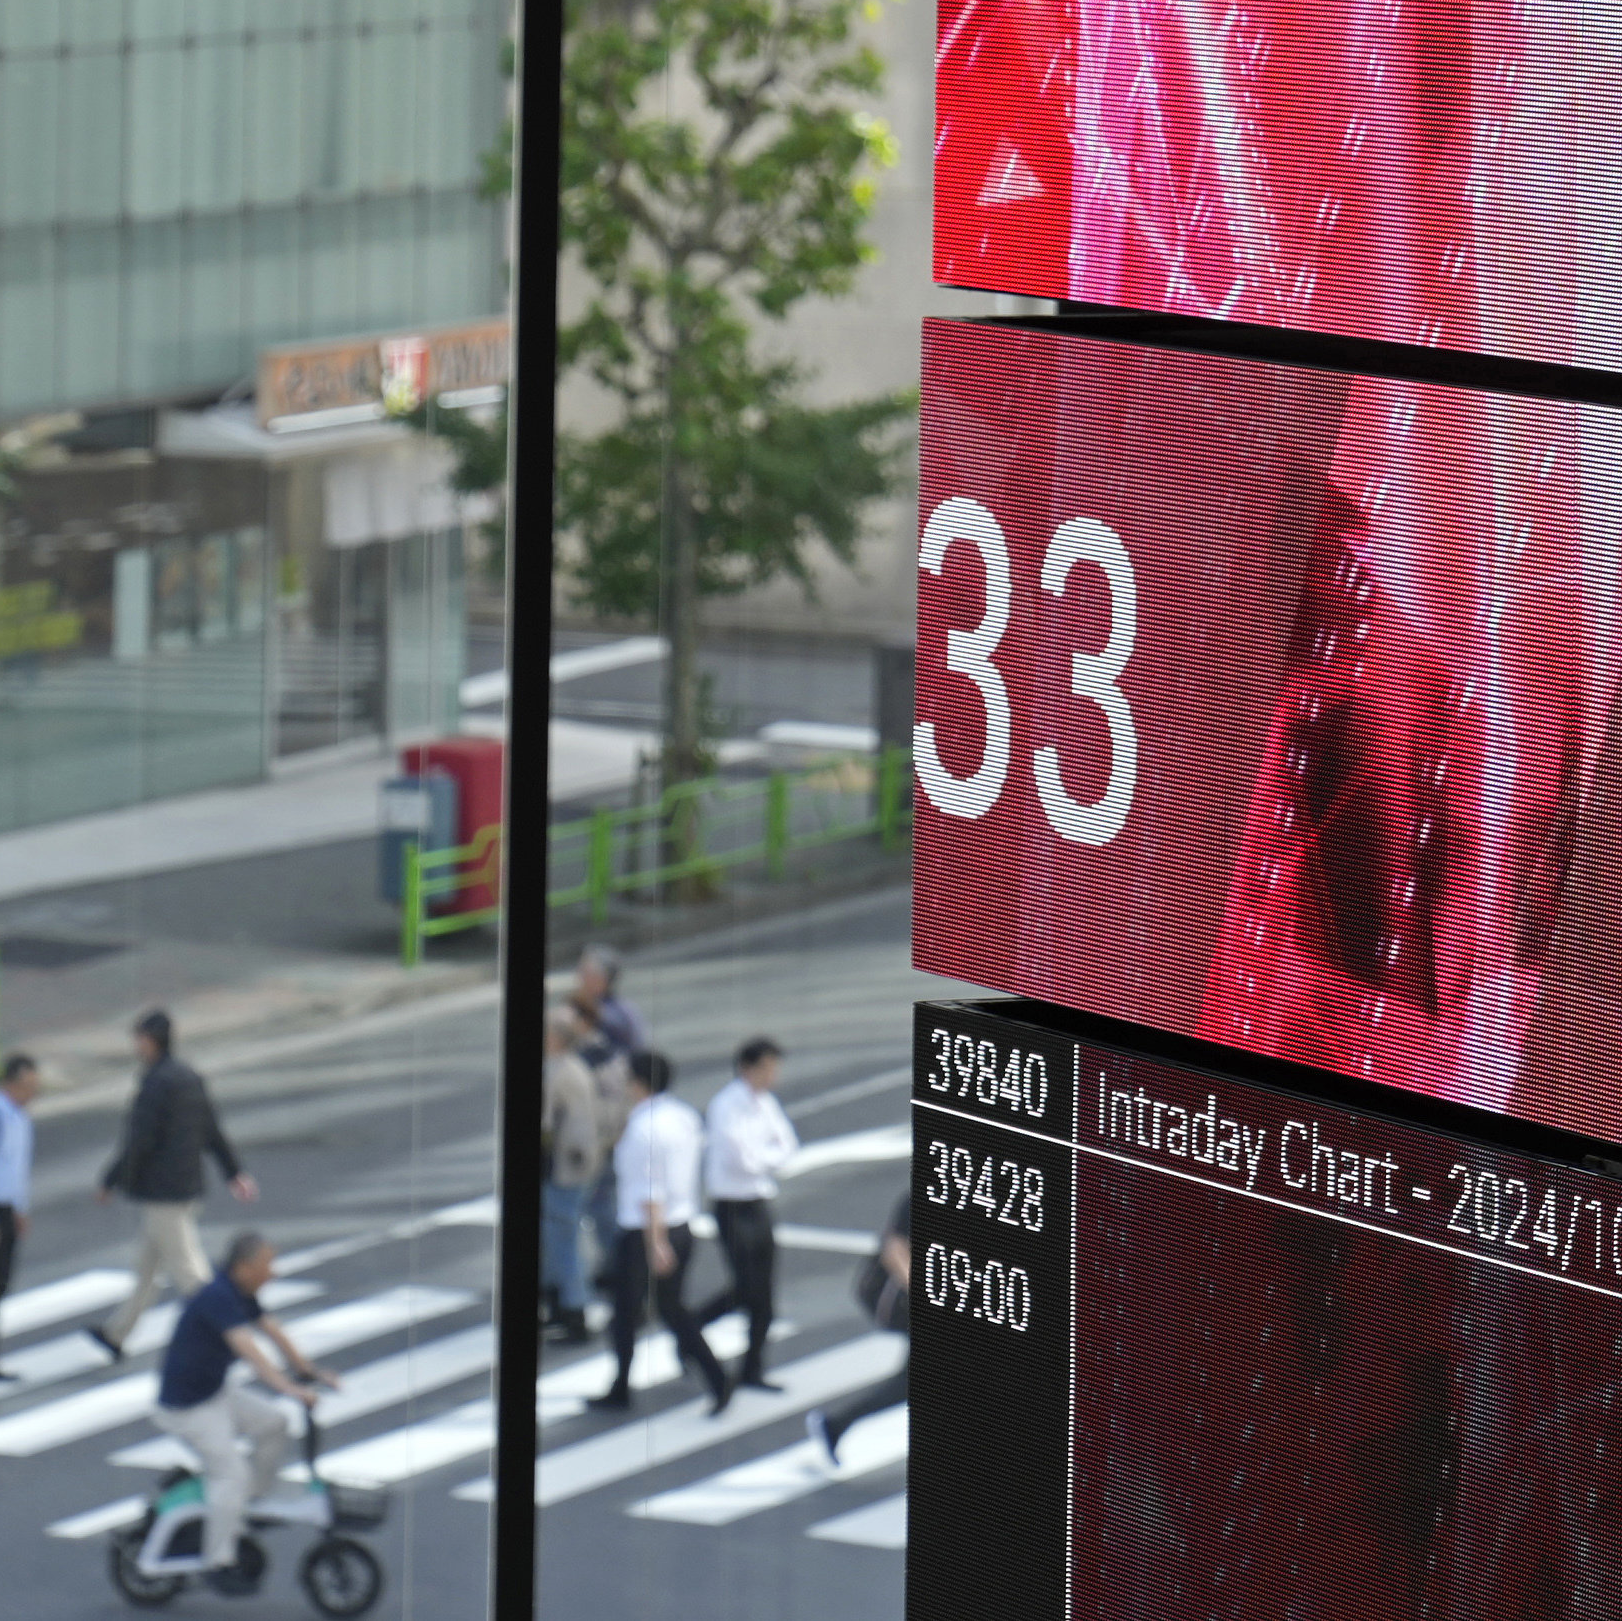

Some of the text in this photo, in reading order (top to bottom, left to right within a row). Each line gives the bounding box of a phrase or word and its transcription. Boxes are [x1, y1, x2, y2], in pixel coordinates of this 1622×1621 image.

[912, 497, 1139, 845] 33
[928, 1028, 1049, 1118] 39840
[926, 1141, 1045, 1232] 39428
[1097, 1071, 1266, 1191] Intraday
[1280, 1120, 1399, 1214] Chart
[1412, 1186, 1432, 1201] -
[925, 1243, 1031, 1332] 09:00
